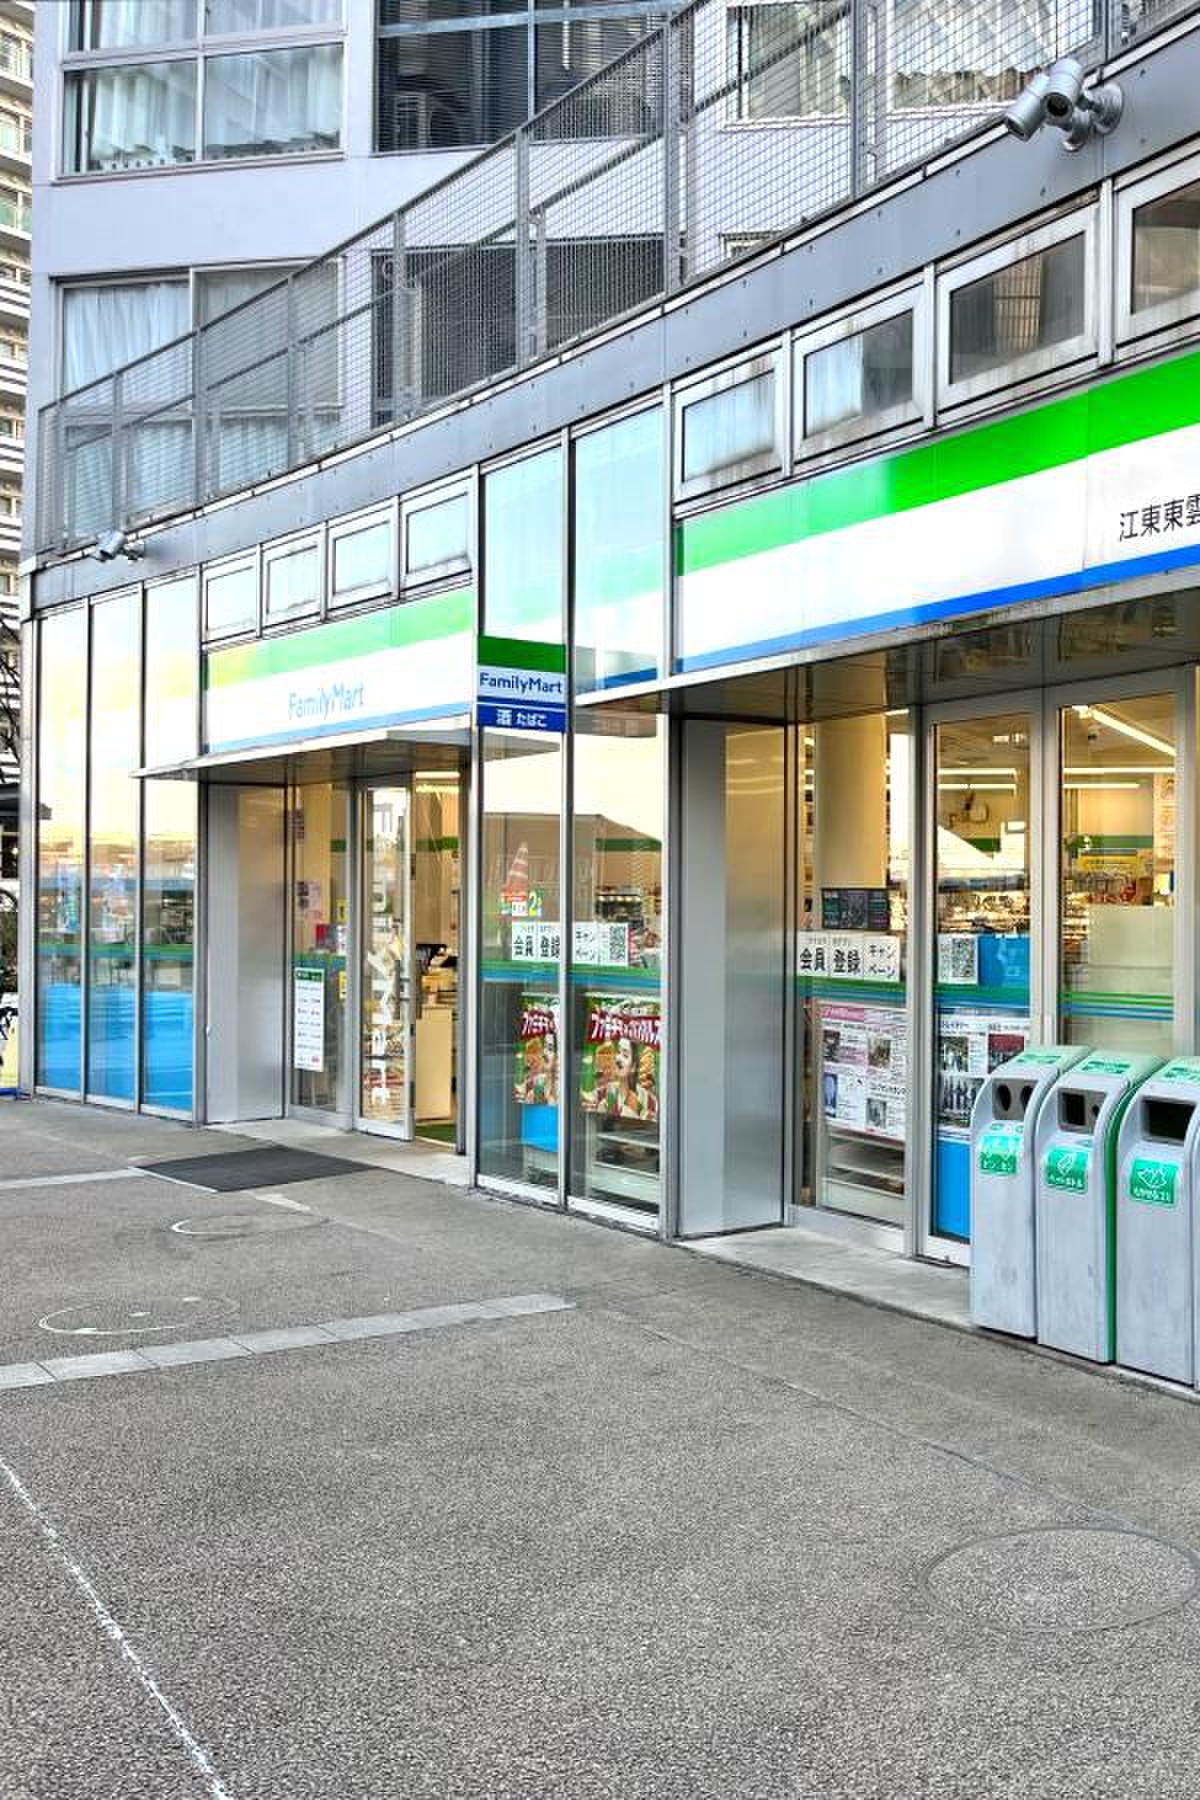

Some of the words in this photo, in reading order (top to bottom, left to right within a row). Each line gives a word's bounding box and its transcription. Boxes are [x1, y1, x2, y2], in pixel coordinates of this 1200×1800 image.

[479, 671, 563, 696] FamilyMart
[287, 681, 365, 721] FamilyMart
[515, 711, 549, 728] たばこ
[799, 947, 825, 972] 会員
[832, 948, 861, 975] 登録
